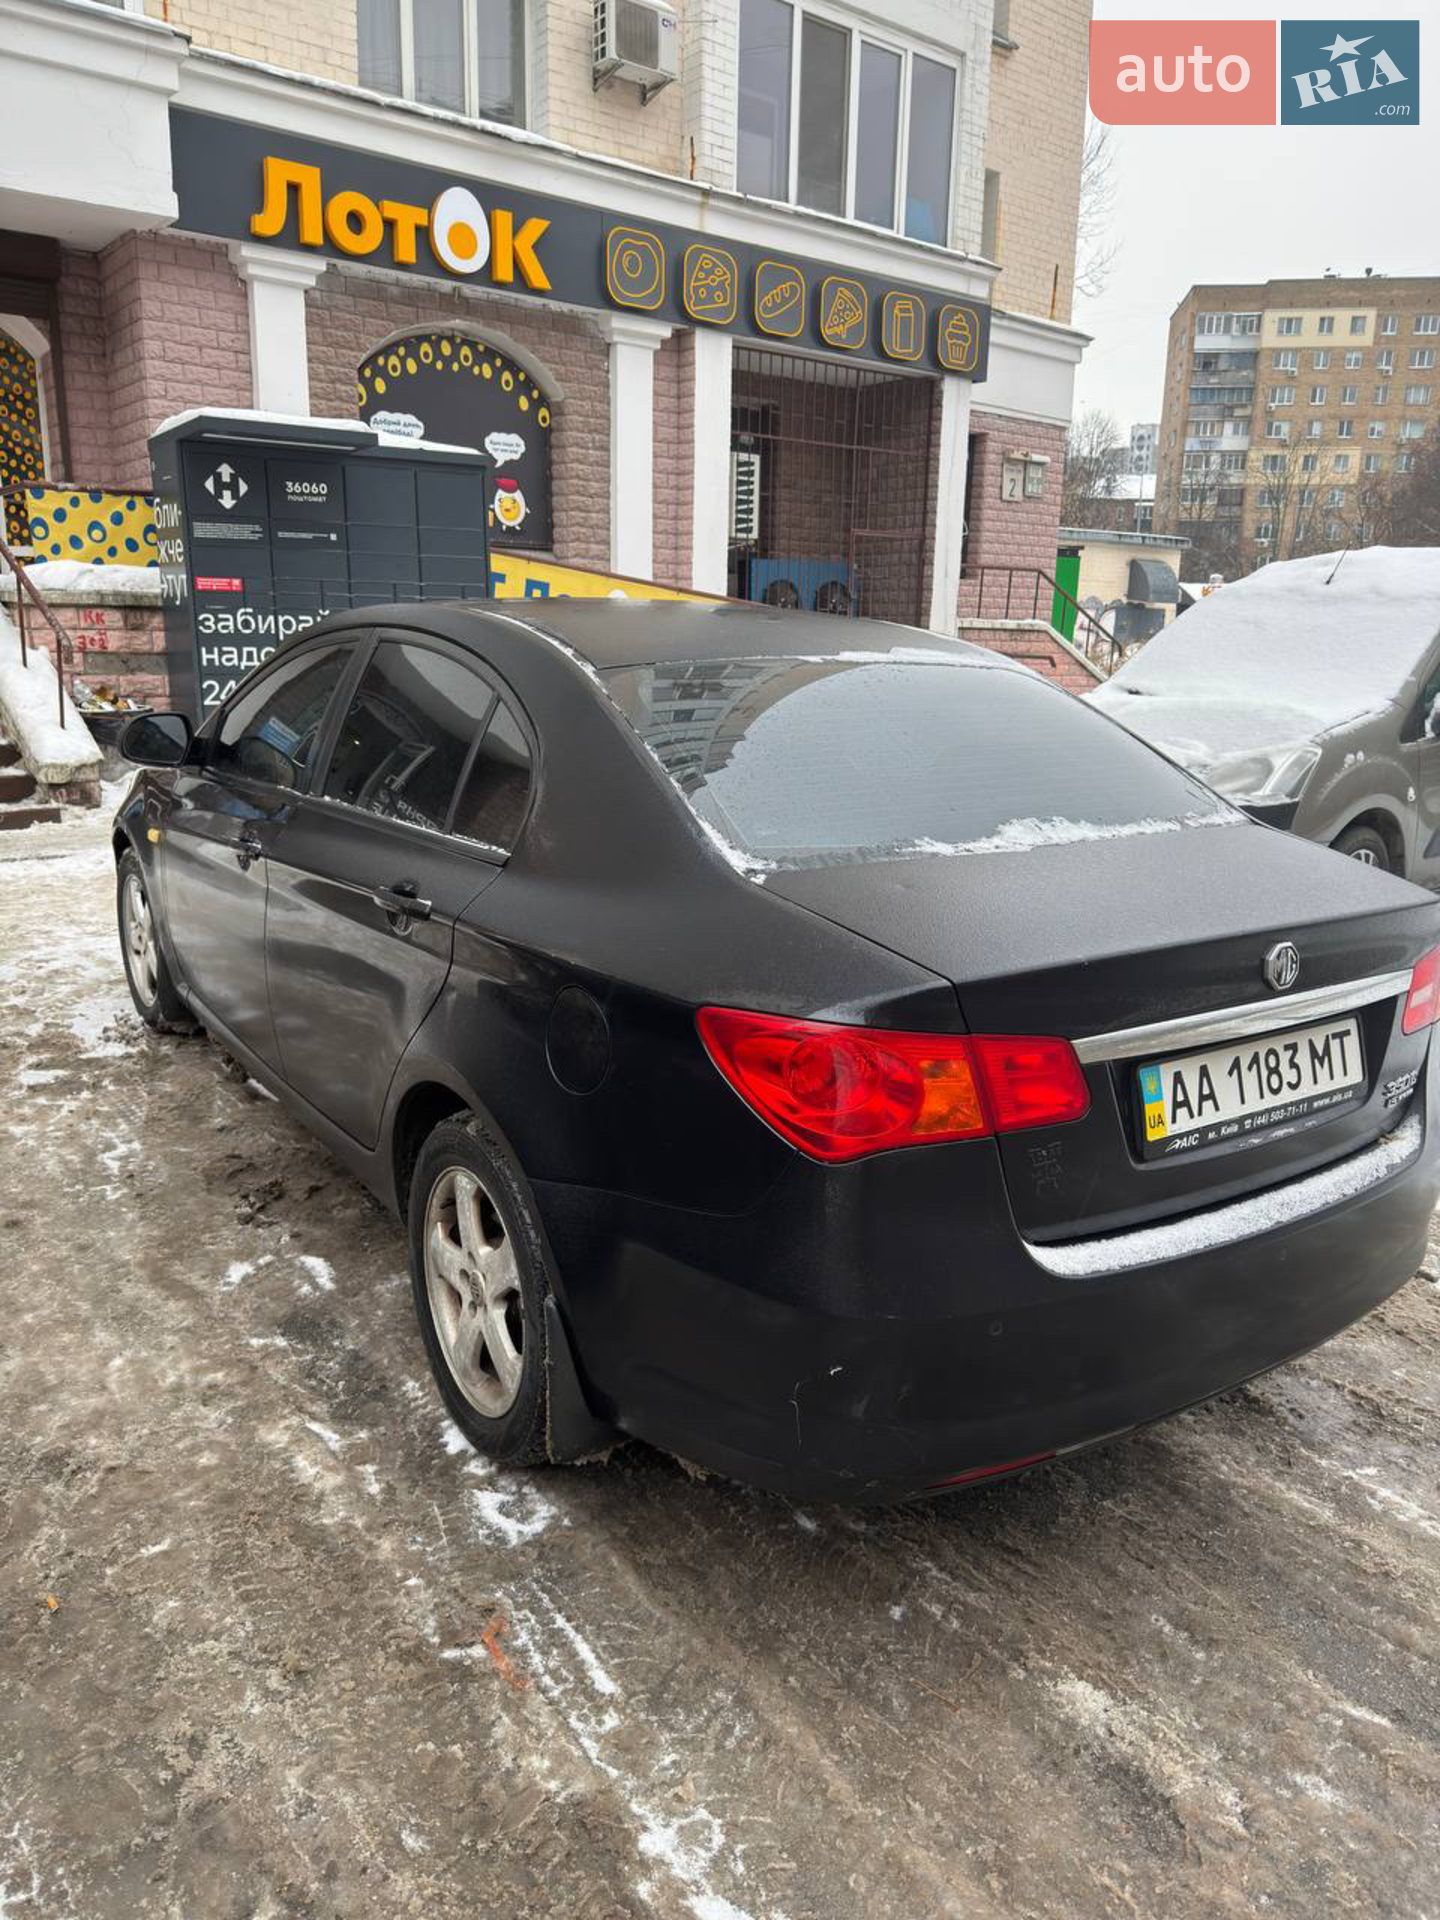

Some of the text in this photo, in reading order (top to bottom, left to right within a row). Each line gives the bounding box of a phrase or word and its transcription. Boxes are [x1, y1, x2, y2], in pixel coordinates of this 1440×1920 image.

[285, 481, 328, 494] 36060
[1008, 478, 1017, 498] 2
[156, 538, 184, 563] жче
[198, 608, 330, 640] забира
[1272, 945, 1299, 987] MG
[1171, 1028, 1352, 1124] AA 1183 MT
[1148, 1113, 1165, 1130] UA
